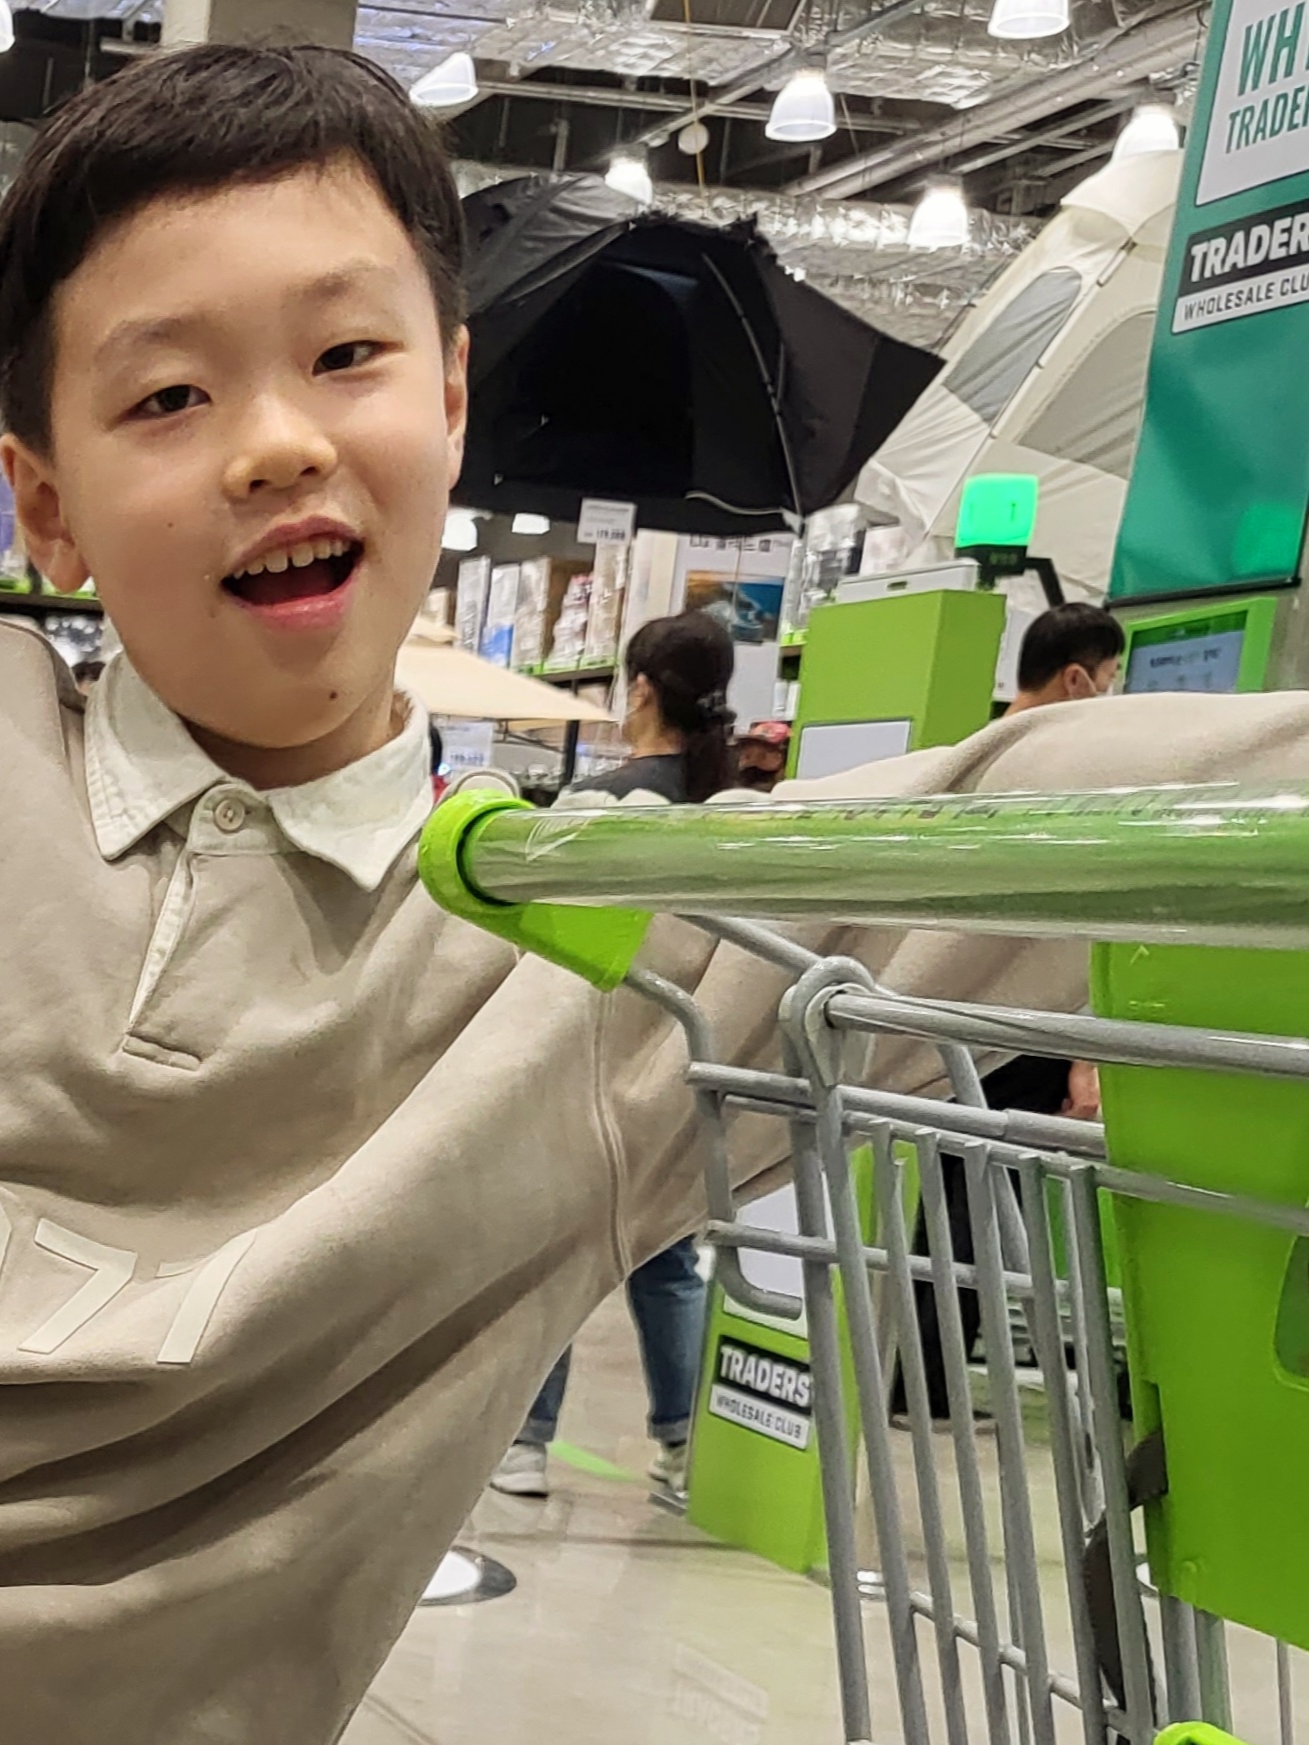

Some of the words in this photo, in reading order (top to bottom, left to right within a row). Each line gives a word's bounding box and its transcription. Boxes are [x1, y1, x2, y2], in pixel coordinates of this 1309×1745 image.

[1238, 0, 1309, 96] WH
[1183, 282, 1276, 321] WHOLESALE
[720, 1345, 811, 1408] TRADERS
[716, 1394, 773, 1429] WHOLESALE
[773, 1416, 802, 1439] CLUB
